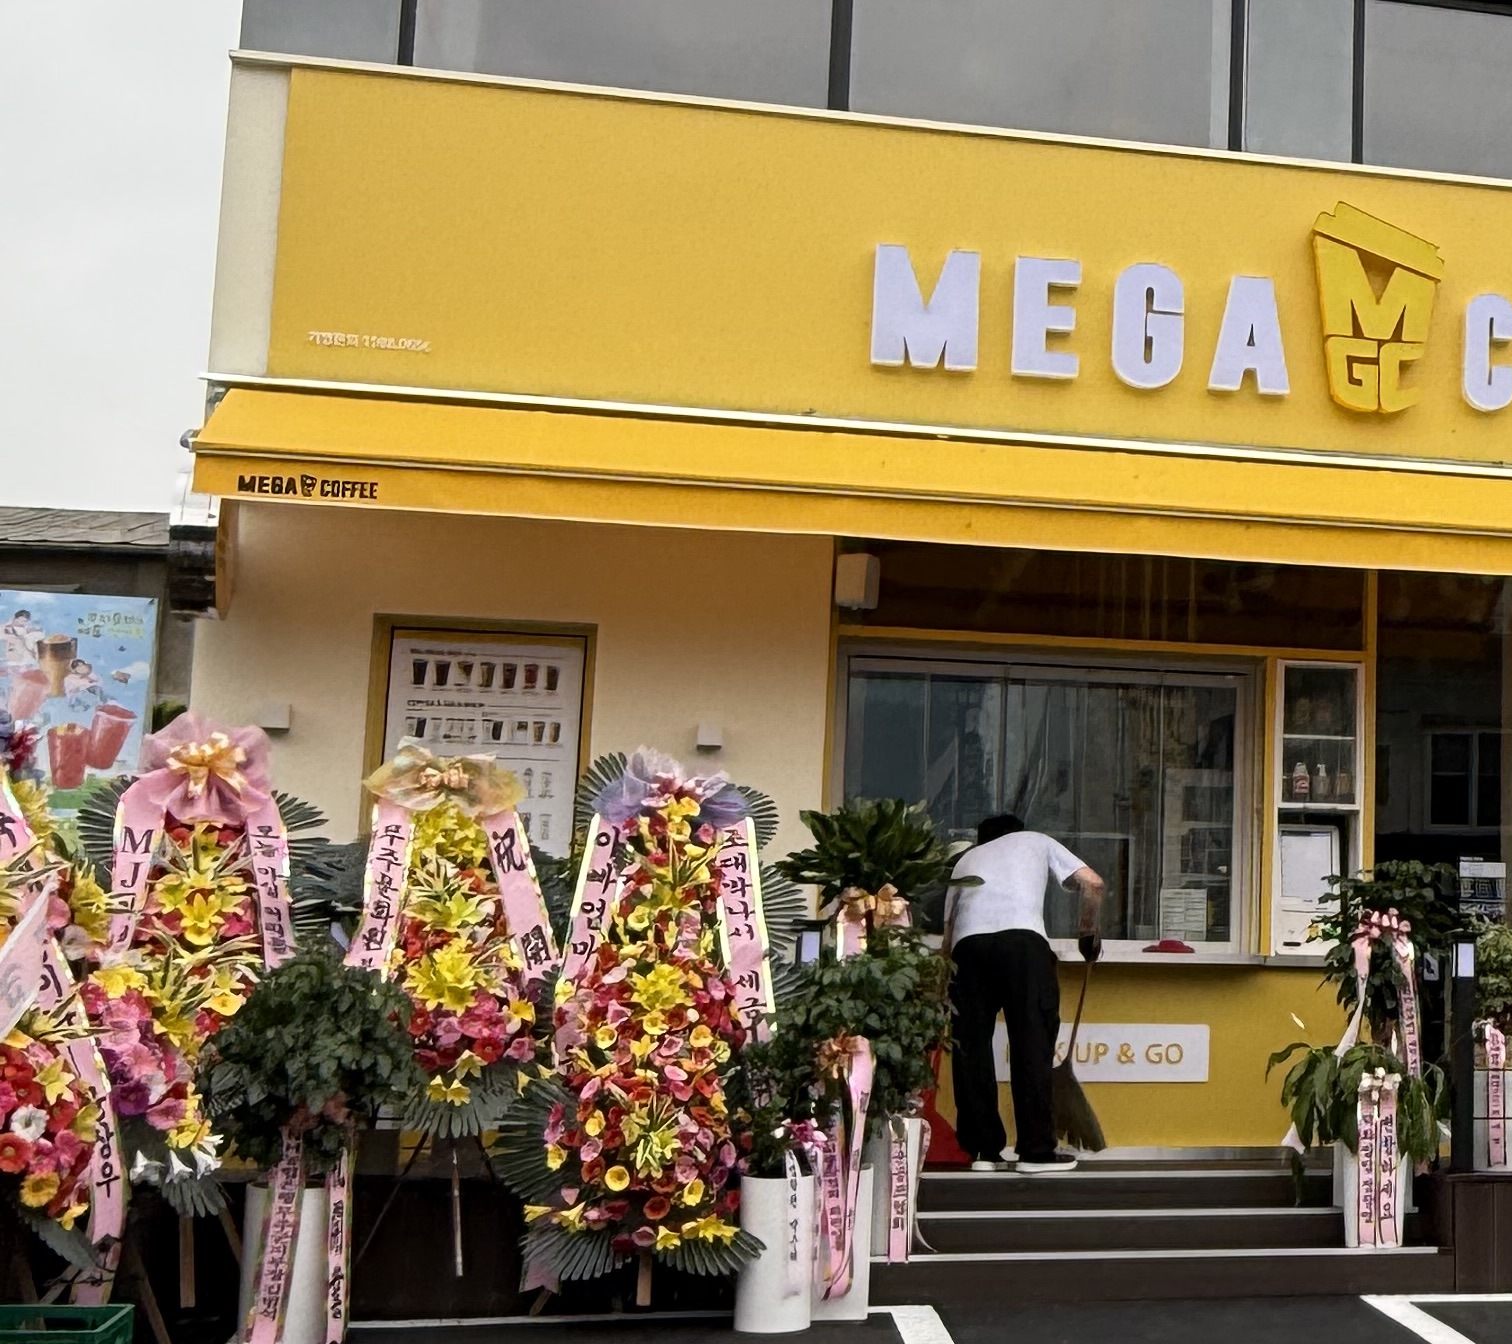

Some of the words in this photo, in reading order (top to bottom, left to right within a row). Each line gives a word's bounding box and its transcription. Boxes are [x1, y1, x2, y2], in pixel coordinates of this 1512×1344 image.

[870, 244, 1290, 396] MEGA
[237, 475, 297, 495] MEGA
[320, 479, 379, 499] COFFEE
[1075, 1042, 1109, 1064] UP
[1117, 1042, 1136, 1064] &
[1145, 1042, 1184, 1064] GO
